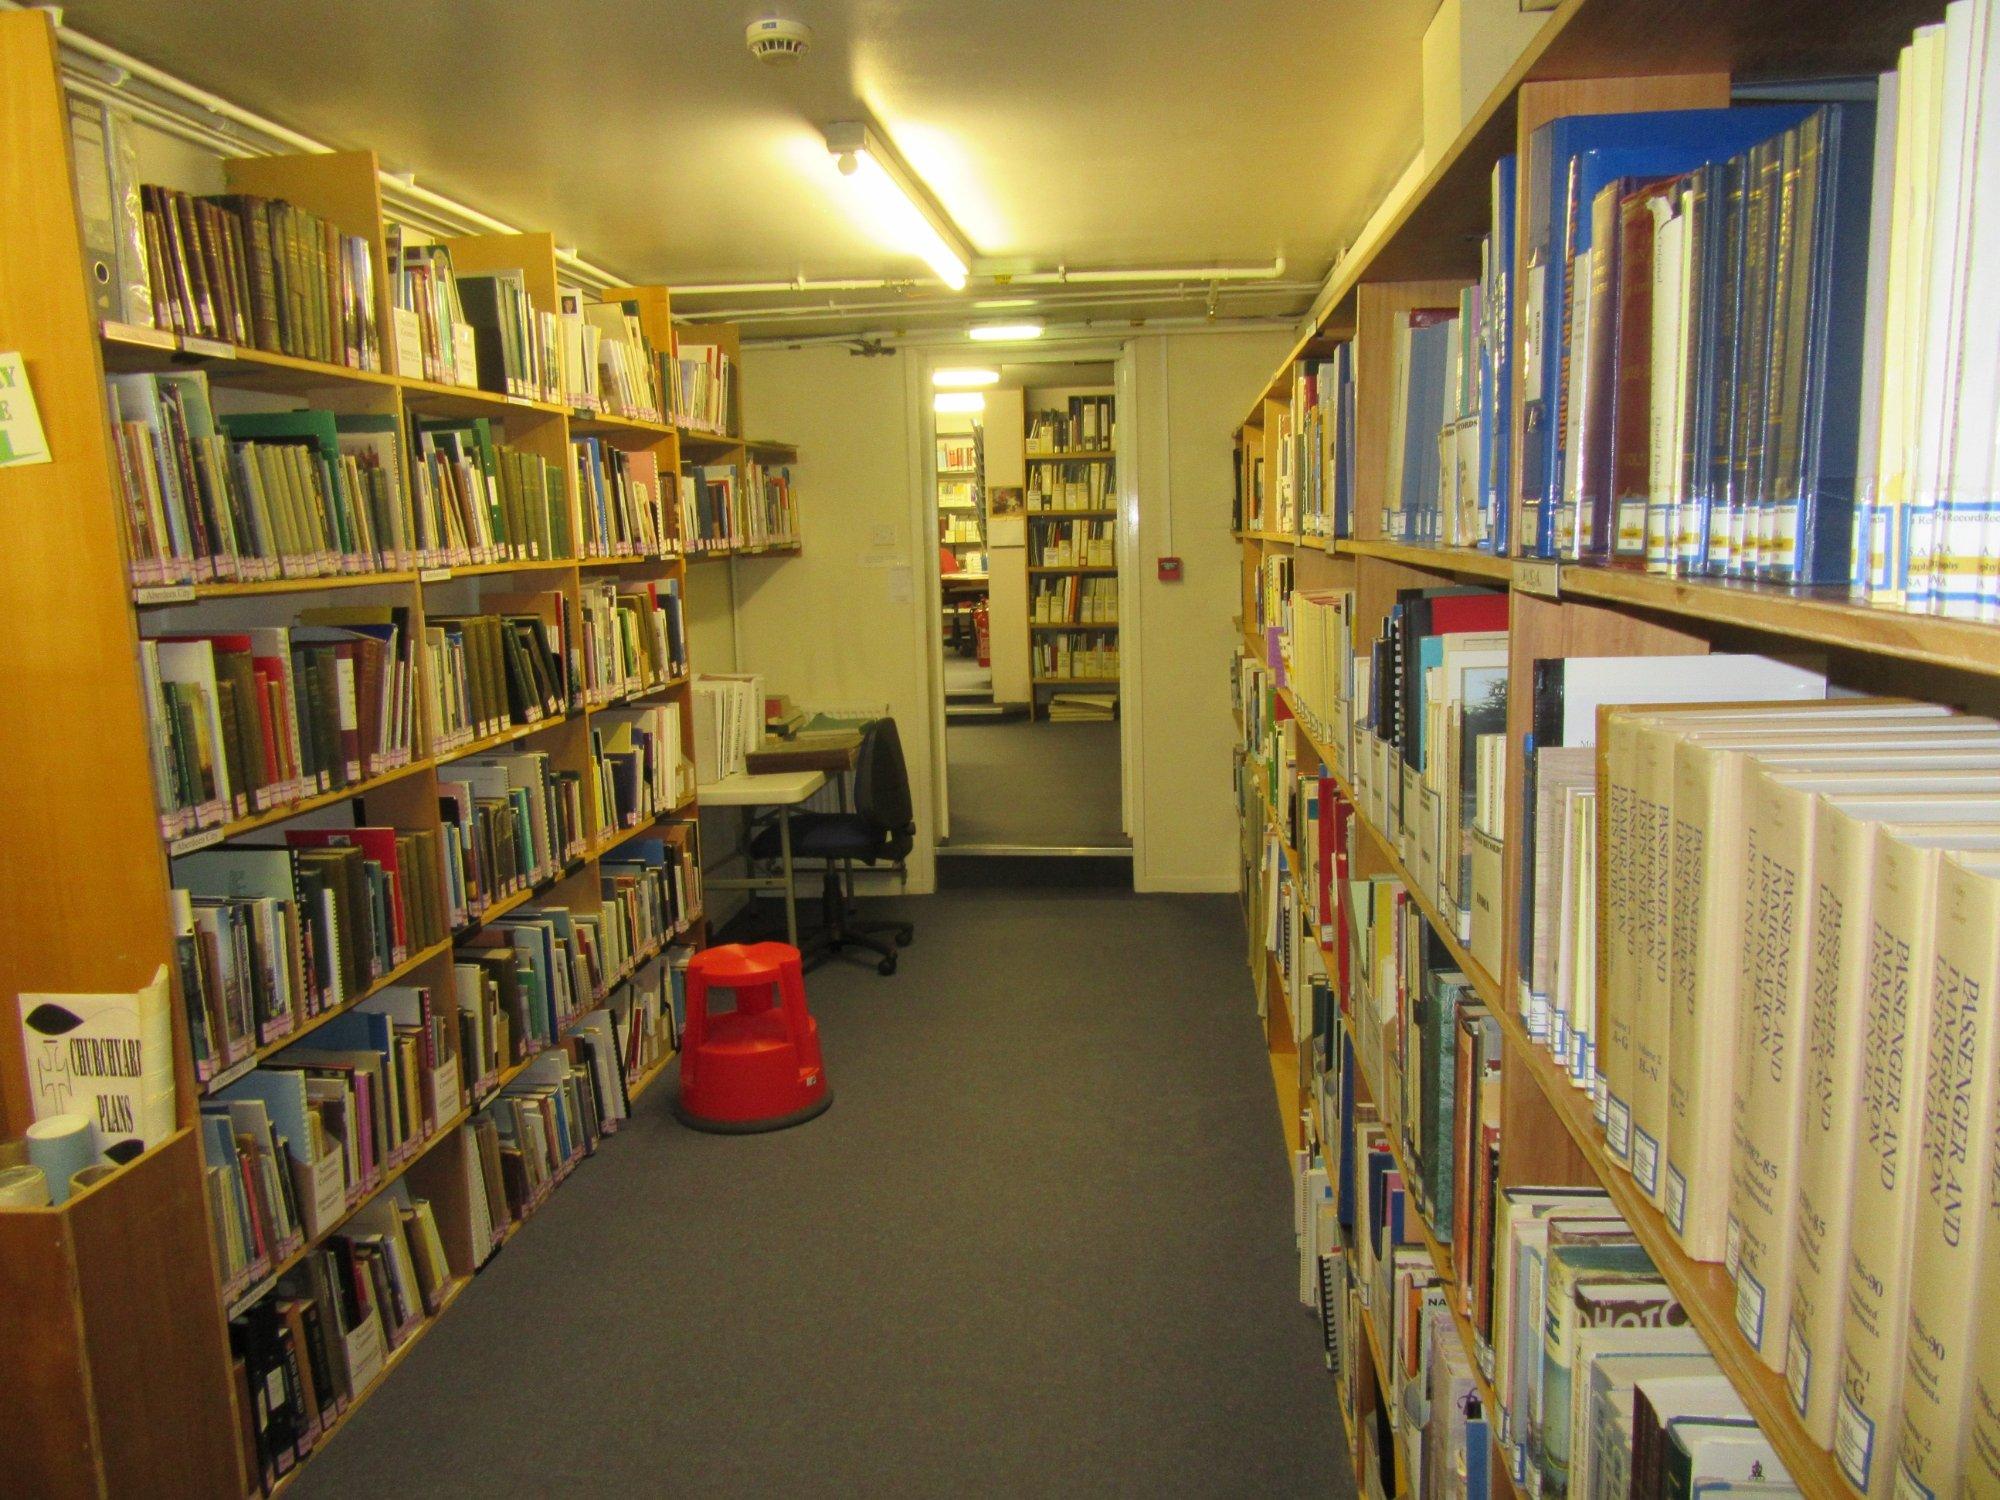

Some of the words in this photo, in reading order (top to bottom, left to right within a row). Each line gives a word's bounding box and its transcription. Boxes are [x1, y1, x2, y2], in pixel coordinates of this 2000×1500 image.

[1558, 356, 1571, 450] RECORDS
[1656, 804, 1669, 927] PASSENGER
[1759, 854, 1771, 926] LISTS
[1656, 934, 1667, 984] AND
[1759, 859, 1784, 1052] IMMIGRATION
[1775, 868, 1795, 1016] PASSENGER
[1769, 1019, 1785, 1085] AND
[1868, 929, 1895, 1153] IMMIGRATION
[1885, 939, 1911, 1114] PASSENGER
[1949, 975, 1981, 1166] PASSENGER
[96, 1094, 134, 1133] PLANS
[1929, 964, 1962, 1206] IMMIGRATION
[1880, 1116, 1899, 1192] AND
[1943, 1167, 1964, 1248] AND
